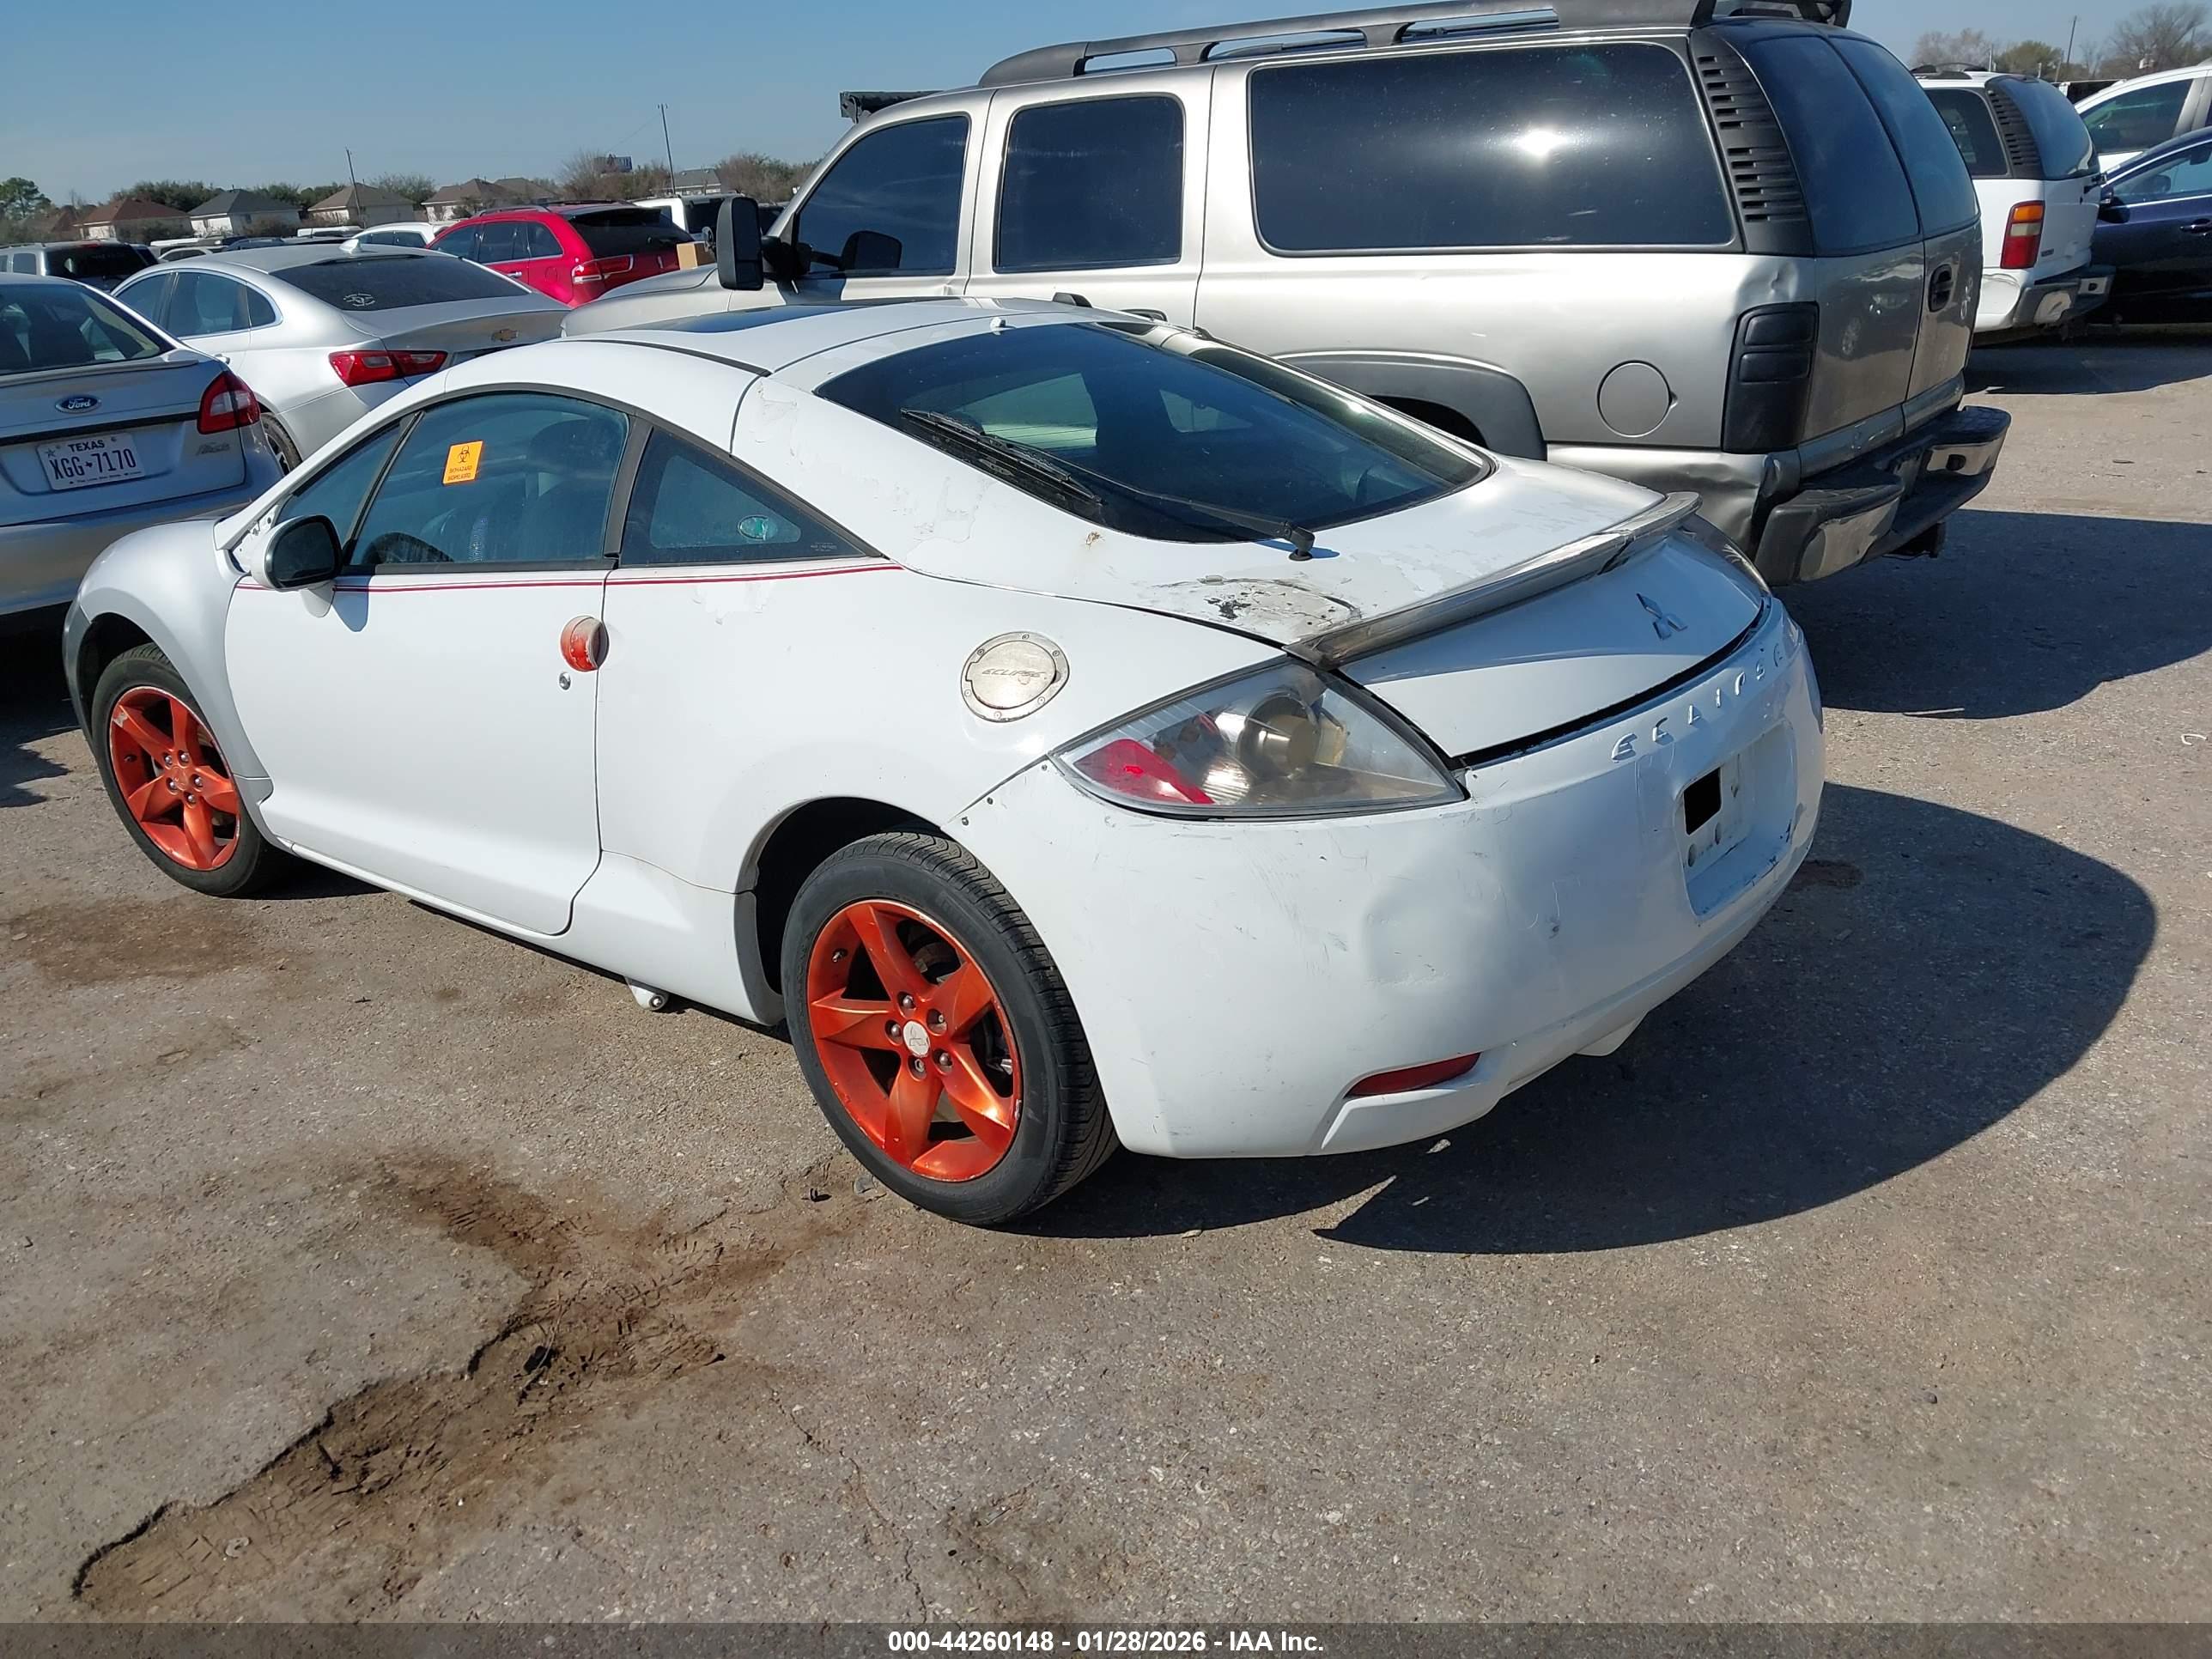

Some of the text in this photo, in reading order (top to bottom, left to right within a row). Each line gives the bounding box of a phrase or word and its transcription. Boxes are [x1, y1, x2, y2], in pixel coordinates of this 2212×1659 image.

[67, 398, 92, 409] Ford
[68, 440, 105, 453] TEXAS
[1611, 643, 1784, 763] ECLIPSE
